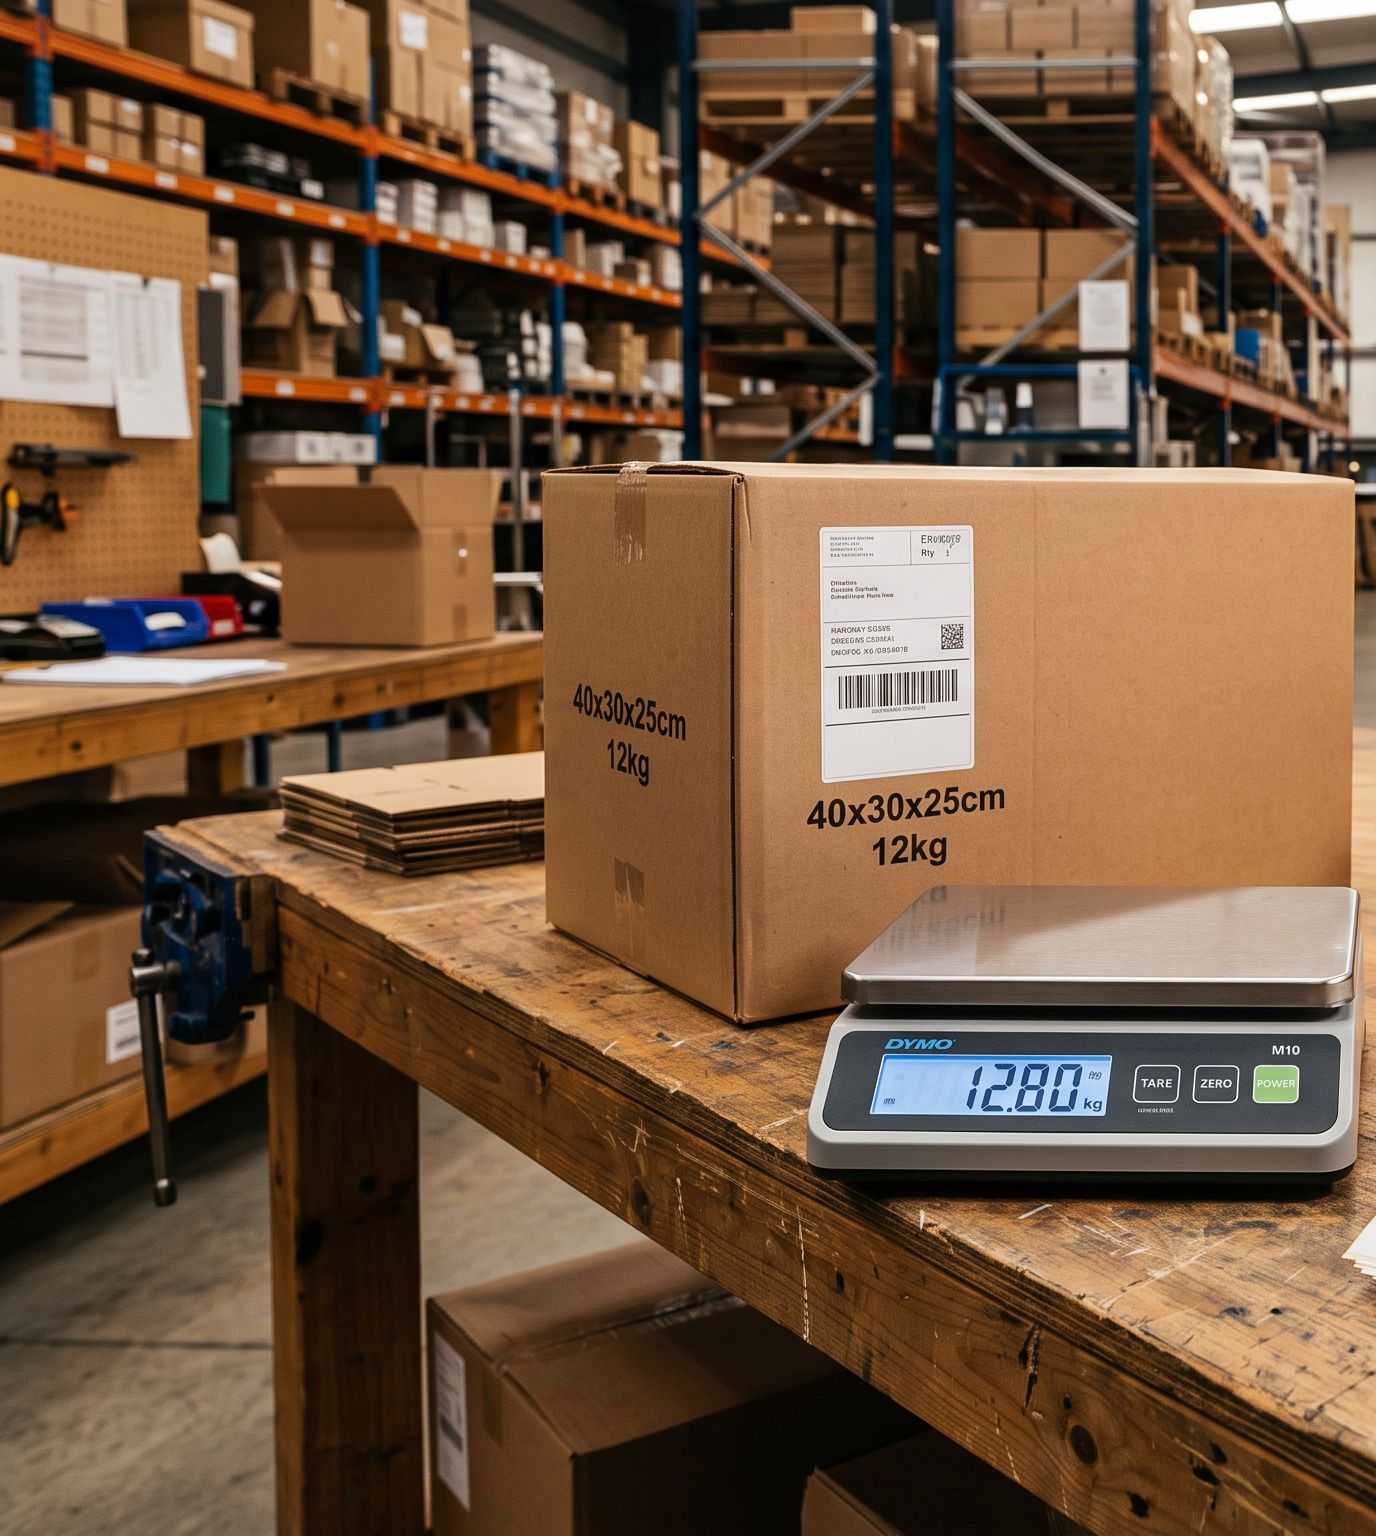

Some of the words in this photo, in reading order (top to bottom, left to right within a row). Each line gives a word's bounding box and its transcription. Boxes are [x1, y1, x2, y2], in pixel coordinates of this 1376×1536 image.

[573, 683, 686, 741] 40x30x25cm
[607, 739, 649, 786] 12kg
[807, 786, 1005, 829] 40x30x25cm
[873, 833, 947, 866] 12kg
[884, 1038, 955, 1050] DYMO
[1272, 1045, 1301, 1056] M10
[966, 1063, 1083, 1113] 12.80
[1083, 1098, 1103, 1112] kg
[1141, 1078, 1173, 1089] TARE
[1200, 1079, 1233, 1089] ZERO
[1257, 1079, 1296, 1089] POWER
